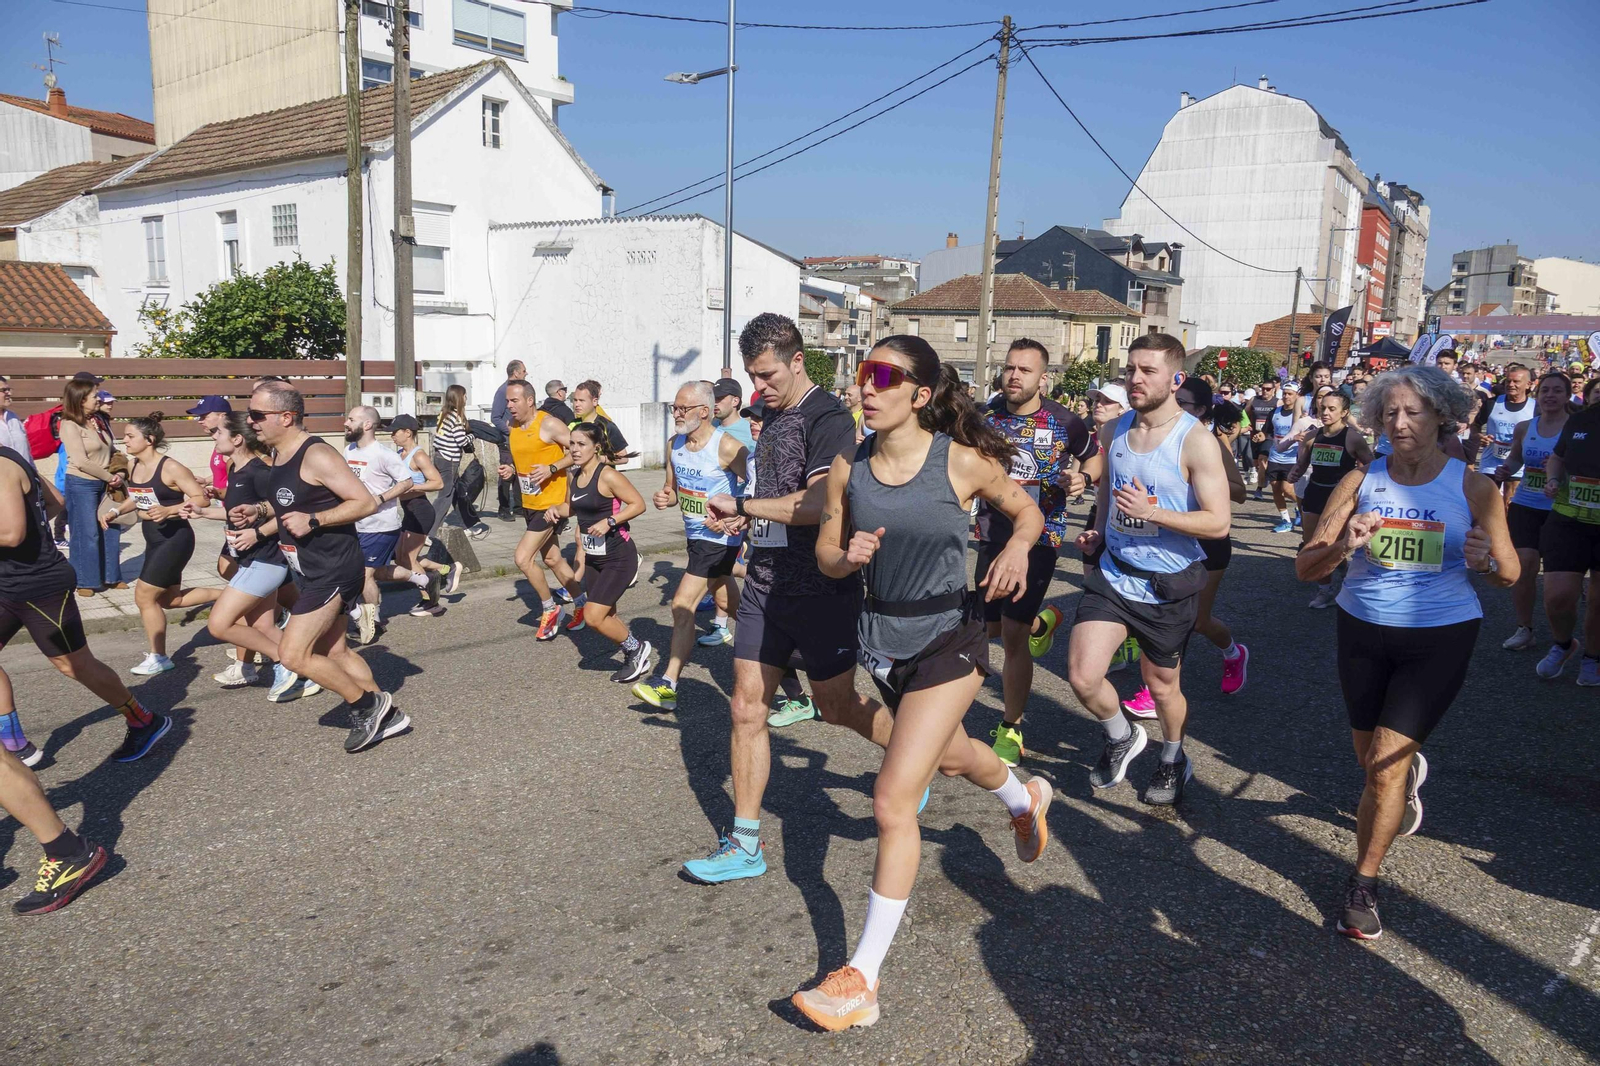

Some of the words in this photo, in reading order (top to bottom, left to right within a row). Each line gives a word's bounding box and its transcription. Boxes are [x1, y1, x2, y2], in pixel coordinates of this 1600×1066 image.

[1315, 450, 1336, 463] 2139
[680, 496, 703, 514] 2260
[1379, 535, 1424, 562] 2161
[836, 992, 867, 1018] TERREX
